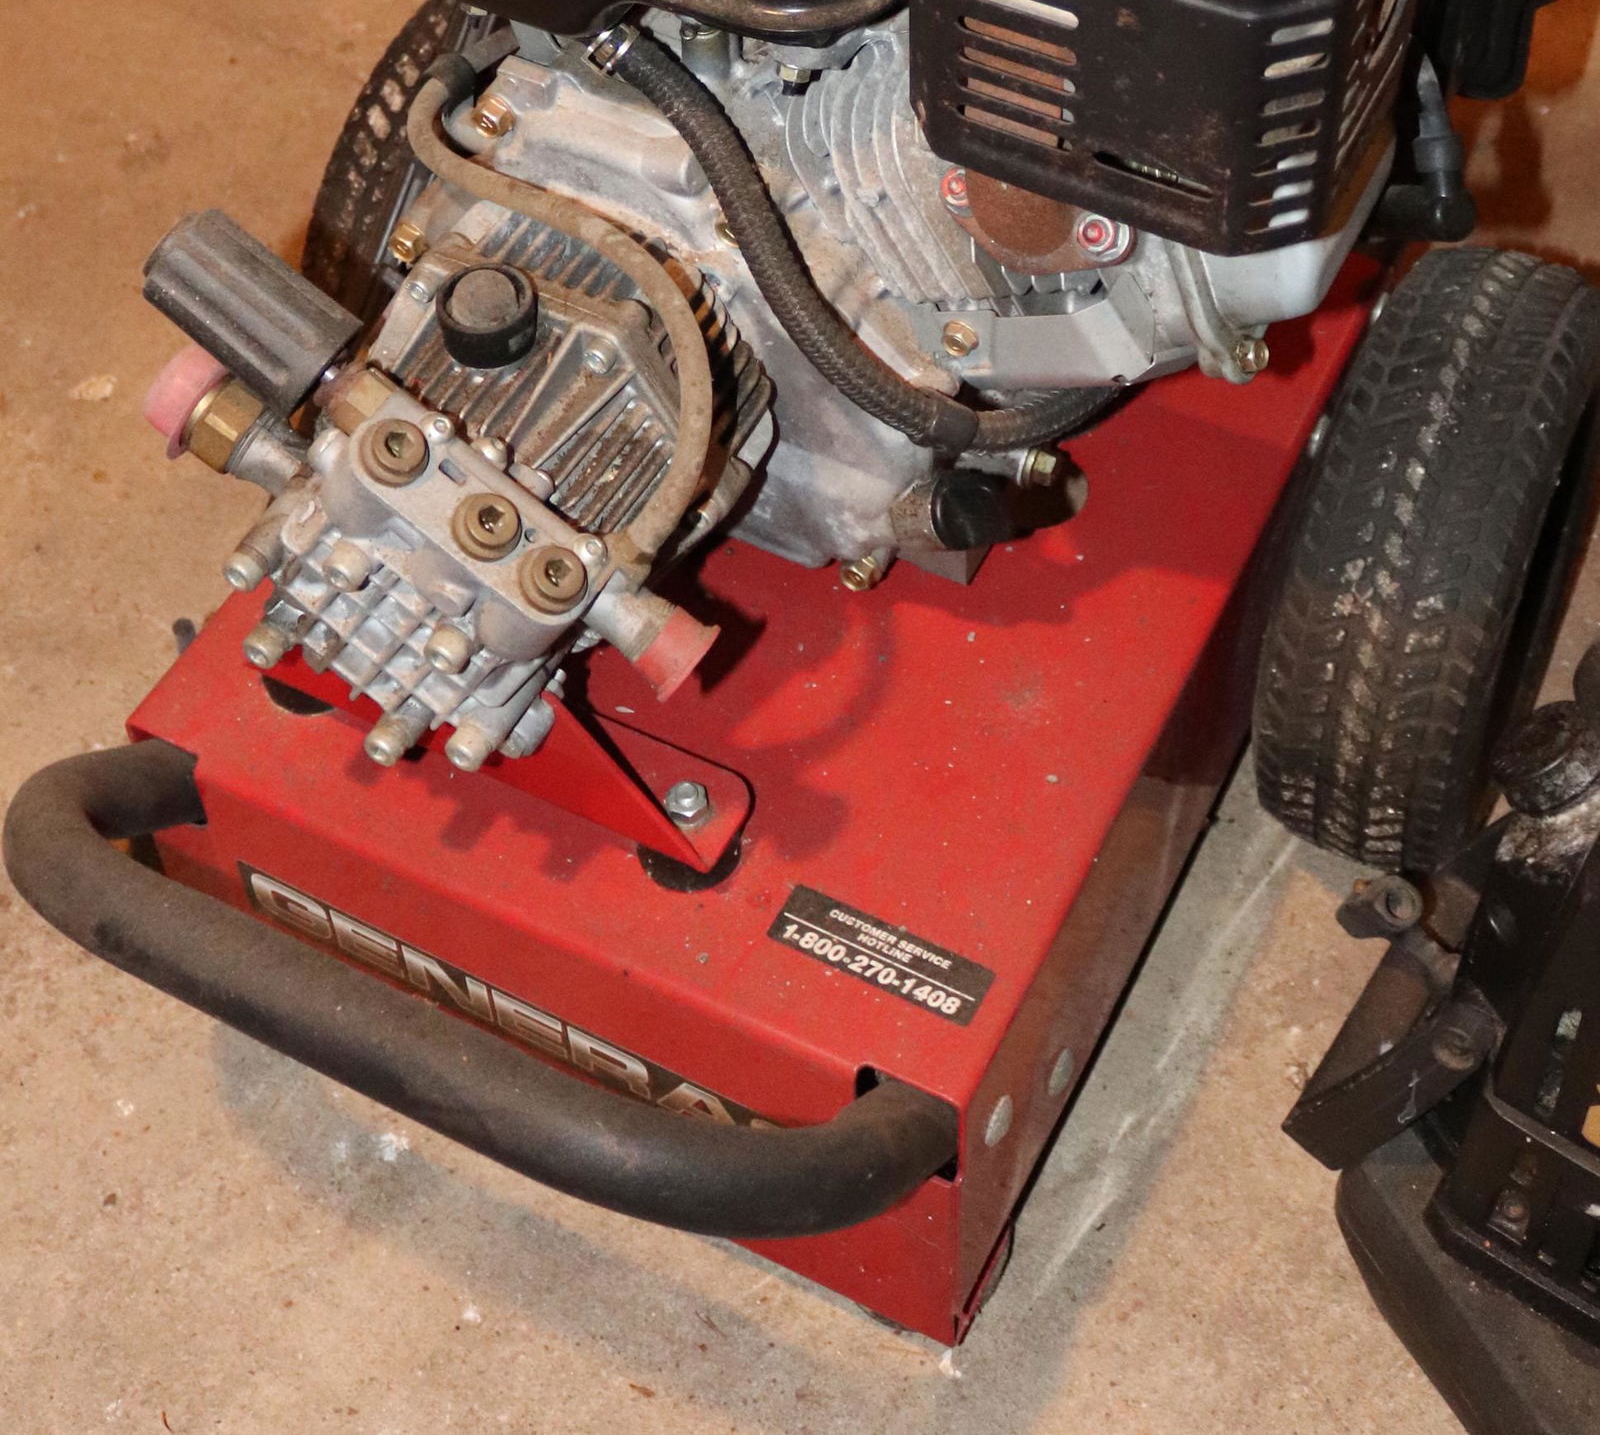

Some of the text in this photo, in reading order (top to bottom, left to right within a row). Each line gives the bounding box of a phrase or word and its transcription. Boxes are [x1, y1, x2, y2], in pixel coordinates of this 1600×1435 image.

[781, 923, 962, 1015] 1-800-270-1408
[829, 909, 953, 970] CUSTOMER SERVICE
[856, 933, 914, 964] HOTLINE
[250, 872, 782, 1132] GENERA
